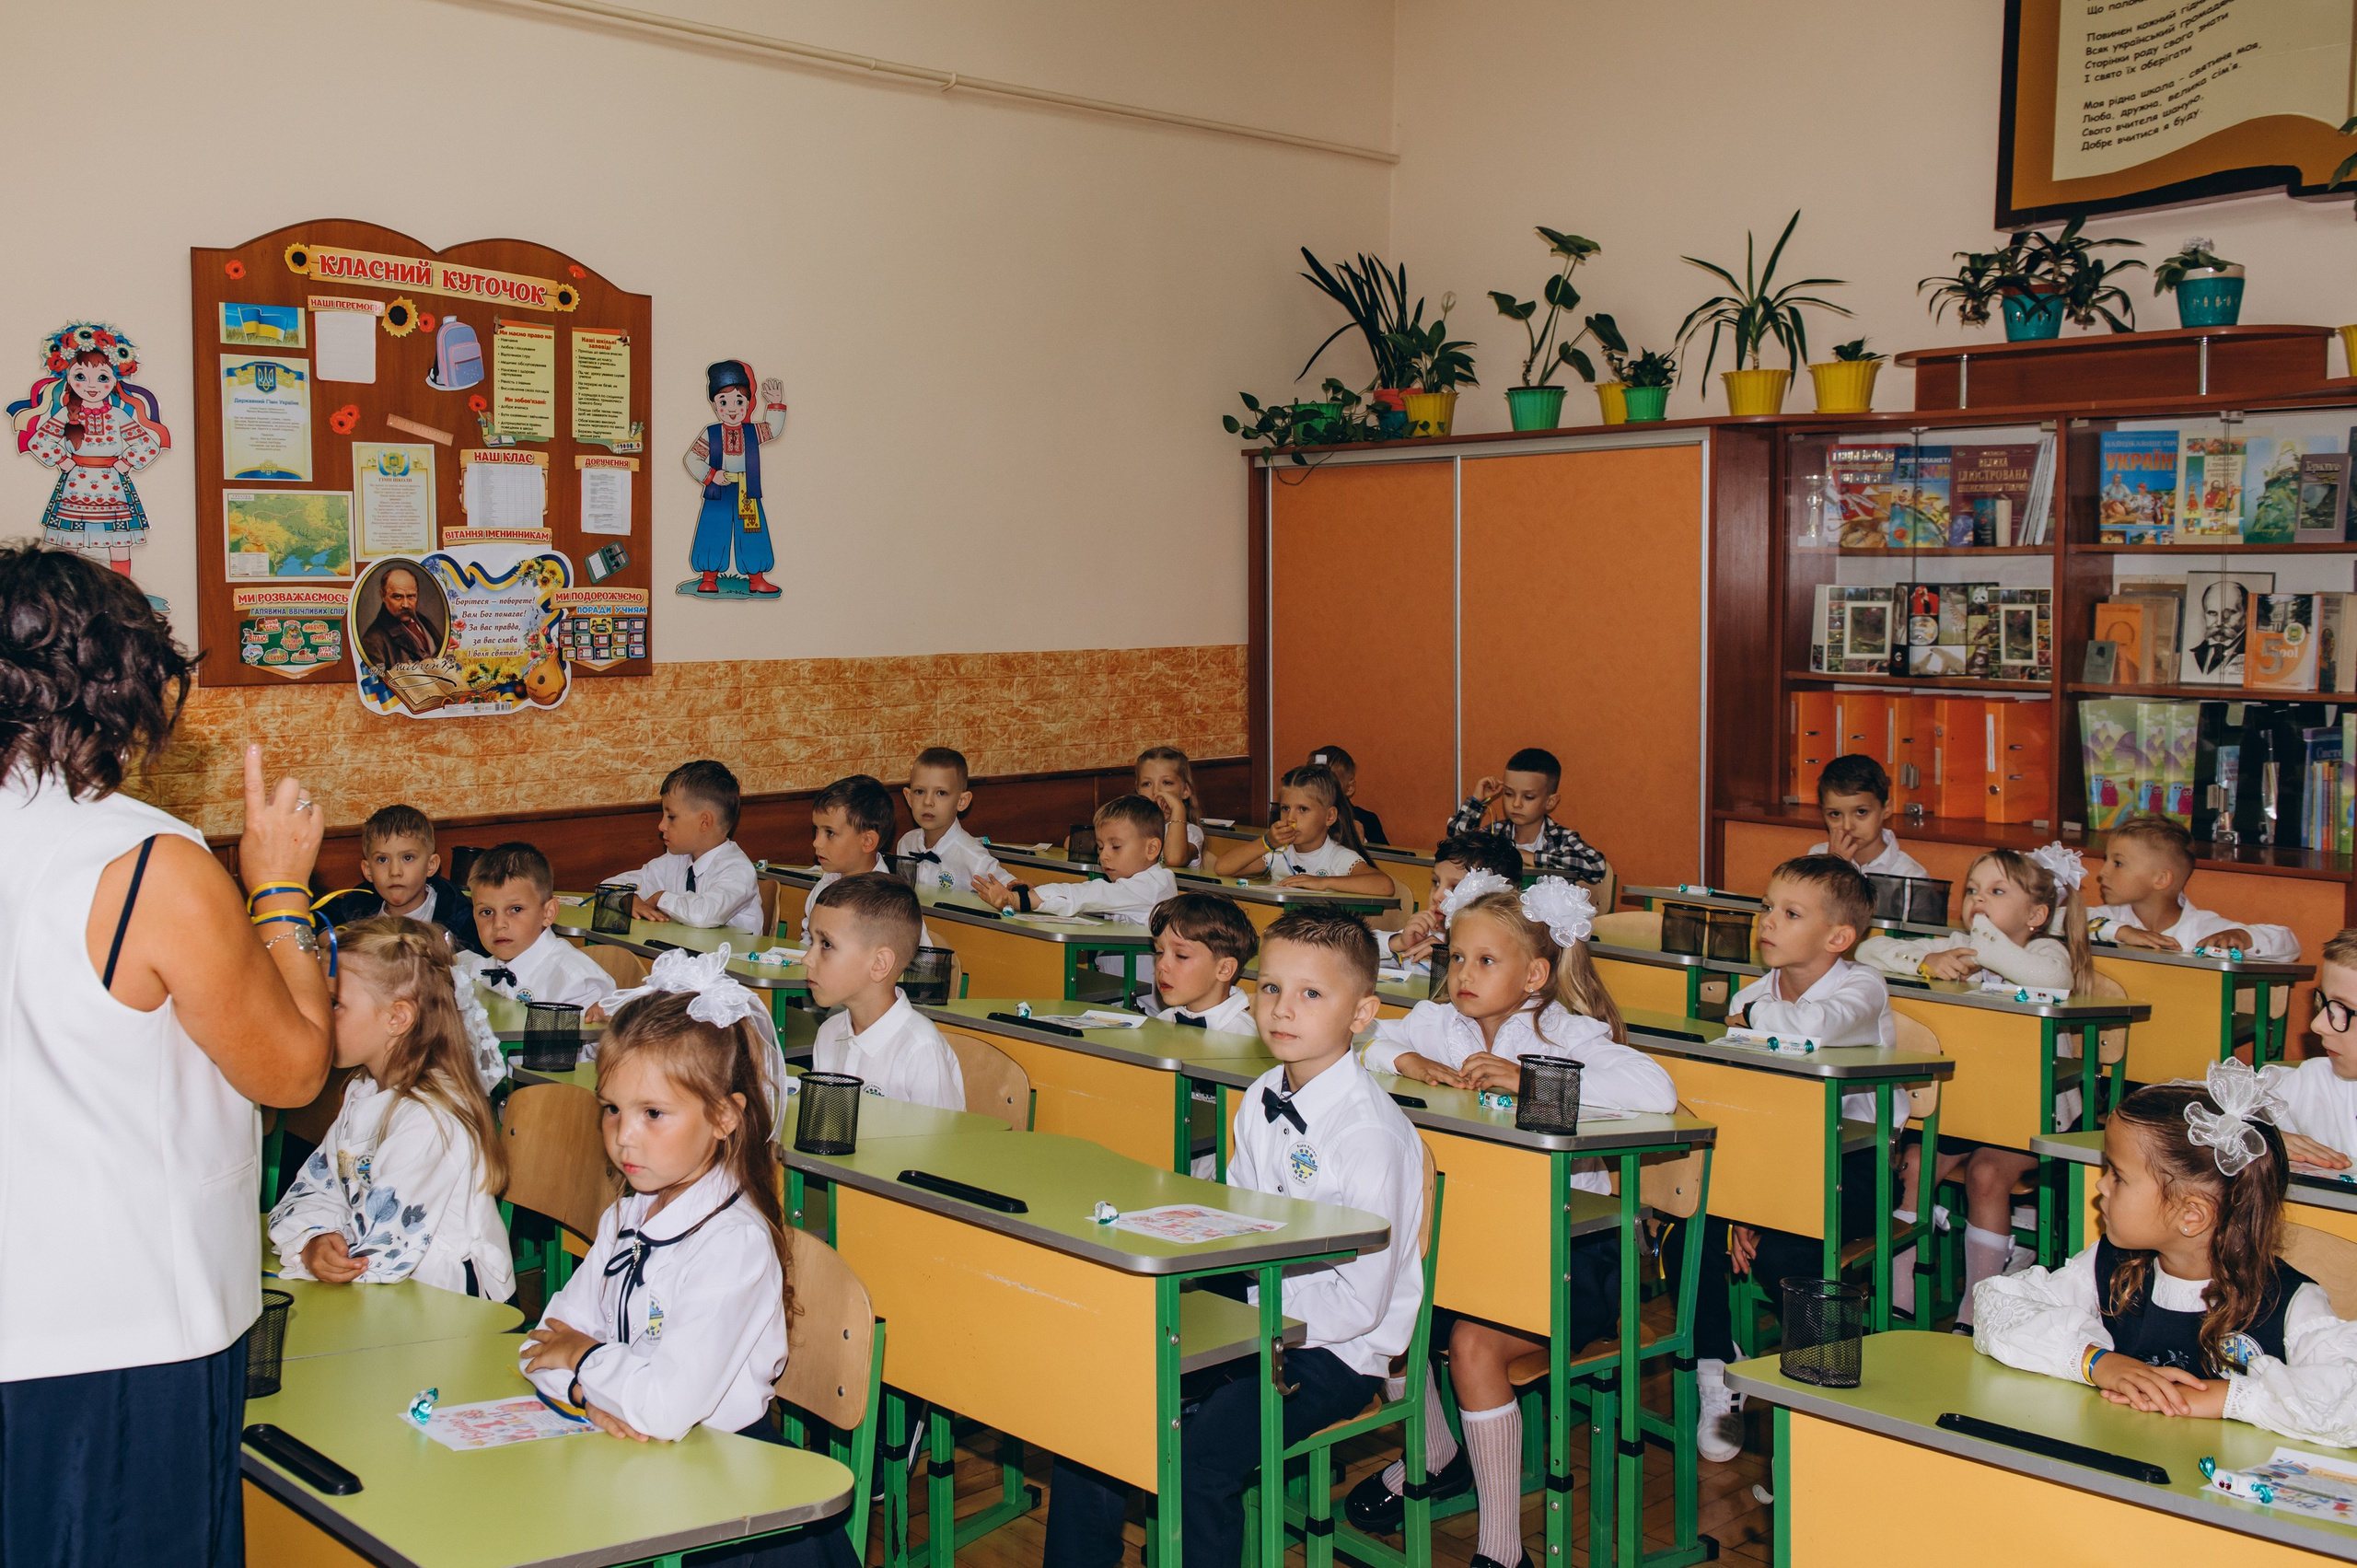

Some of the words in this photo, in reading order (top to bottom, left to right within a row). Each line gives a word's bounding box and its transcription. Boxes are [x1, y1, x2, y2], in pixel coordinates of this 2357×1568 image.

[2087, 6, 2105, 15] Що
[2087, 29, 2132, 42] Повинен
[2137, 9, 2177, 31] кожний
[2084, 55, 2130, 69] Сторінки
[2134, 45, 2159, 62] роду
[2164, 30, 2194, 49] свого
[2198, 12, 2229, 33] знати
[2086, 46, 2108, 55] Всяк
[2113, 24, 2176, 52] український
[2095, 70, 2122, 82] свято
[2127, 66, 2136, 75] їх
[2141, 45, 2192, 71] оберігати
[2084, 101, 2105, 110] Моя
[2108, 94, 2136, 108] рідна
[2141, 81, 2175, 98] школа
[2189, 52, 2232, 78] святиня
[2168, 77, 2207, 101] велика
[2082, 126, 2112, 137] Свого
[2116, 114, 2158, 132] вчителя
[2081, 138, 2113, 151] Добре
[2118, 127, 2159, 145] вчитися
[319, 255, 433, 286] КЛАСНИЙ
[442, 269, 547, 306] КУТОЧОК
[310, 299, 334, 308] НАШІ
[335, 300, 382, 312] ПЕРЕМОГИ
[474, 452, 501, 462] НАШ
[503, 453, 534, 464] КЛАС
[585, 459, 630, 468] ДОРУЧЕННЯ
[445, 530, 484, 540] ВІТАННЯ
[485, 530, 550, 540] ІМЕНИННИКАМ
[238, 594, 256, 604] МИ
[258, 593, 349, 604] РОЗВАЖАЄМОСЬ
[499, 597, 536, 605] поборете!
[556, 593, 570, 601] МИ
[571, 592, 644, 602] ПОДОРОЖУЄМО
[576, 605, 612, 615] ПОРАДИ
[615, 605, 648, 614] УЧНЯМ
[494, 623, 521, 632] правда,
[472, 649, 490, 657] воля
[2258, 638, 2283, 675] 5
